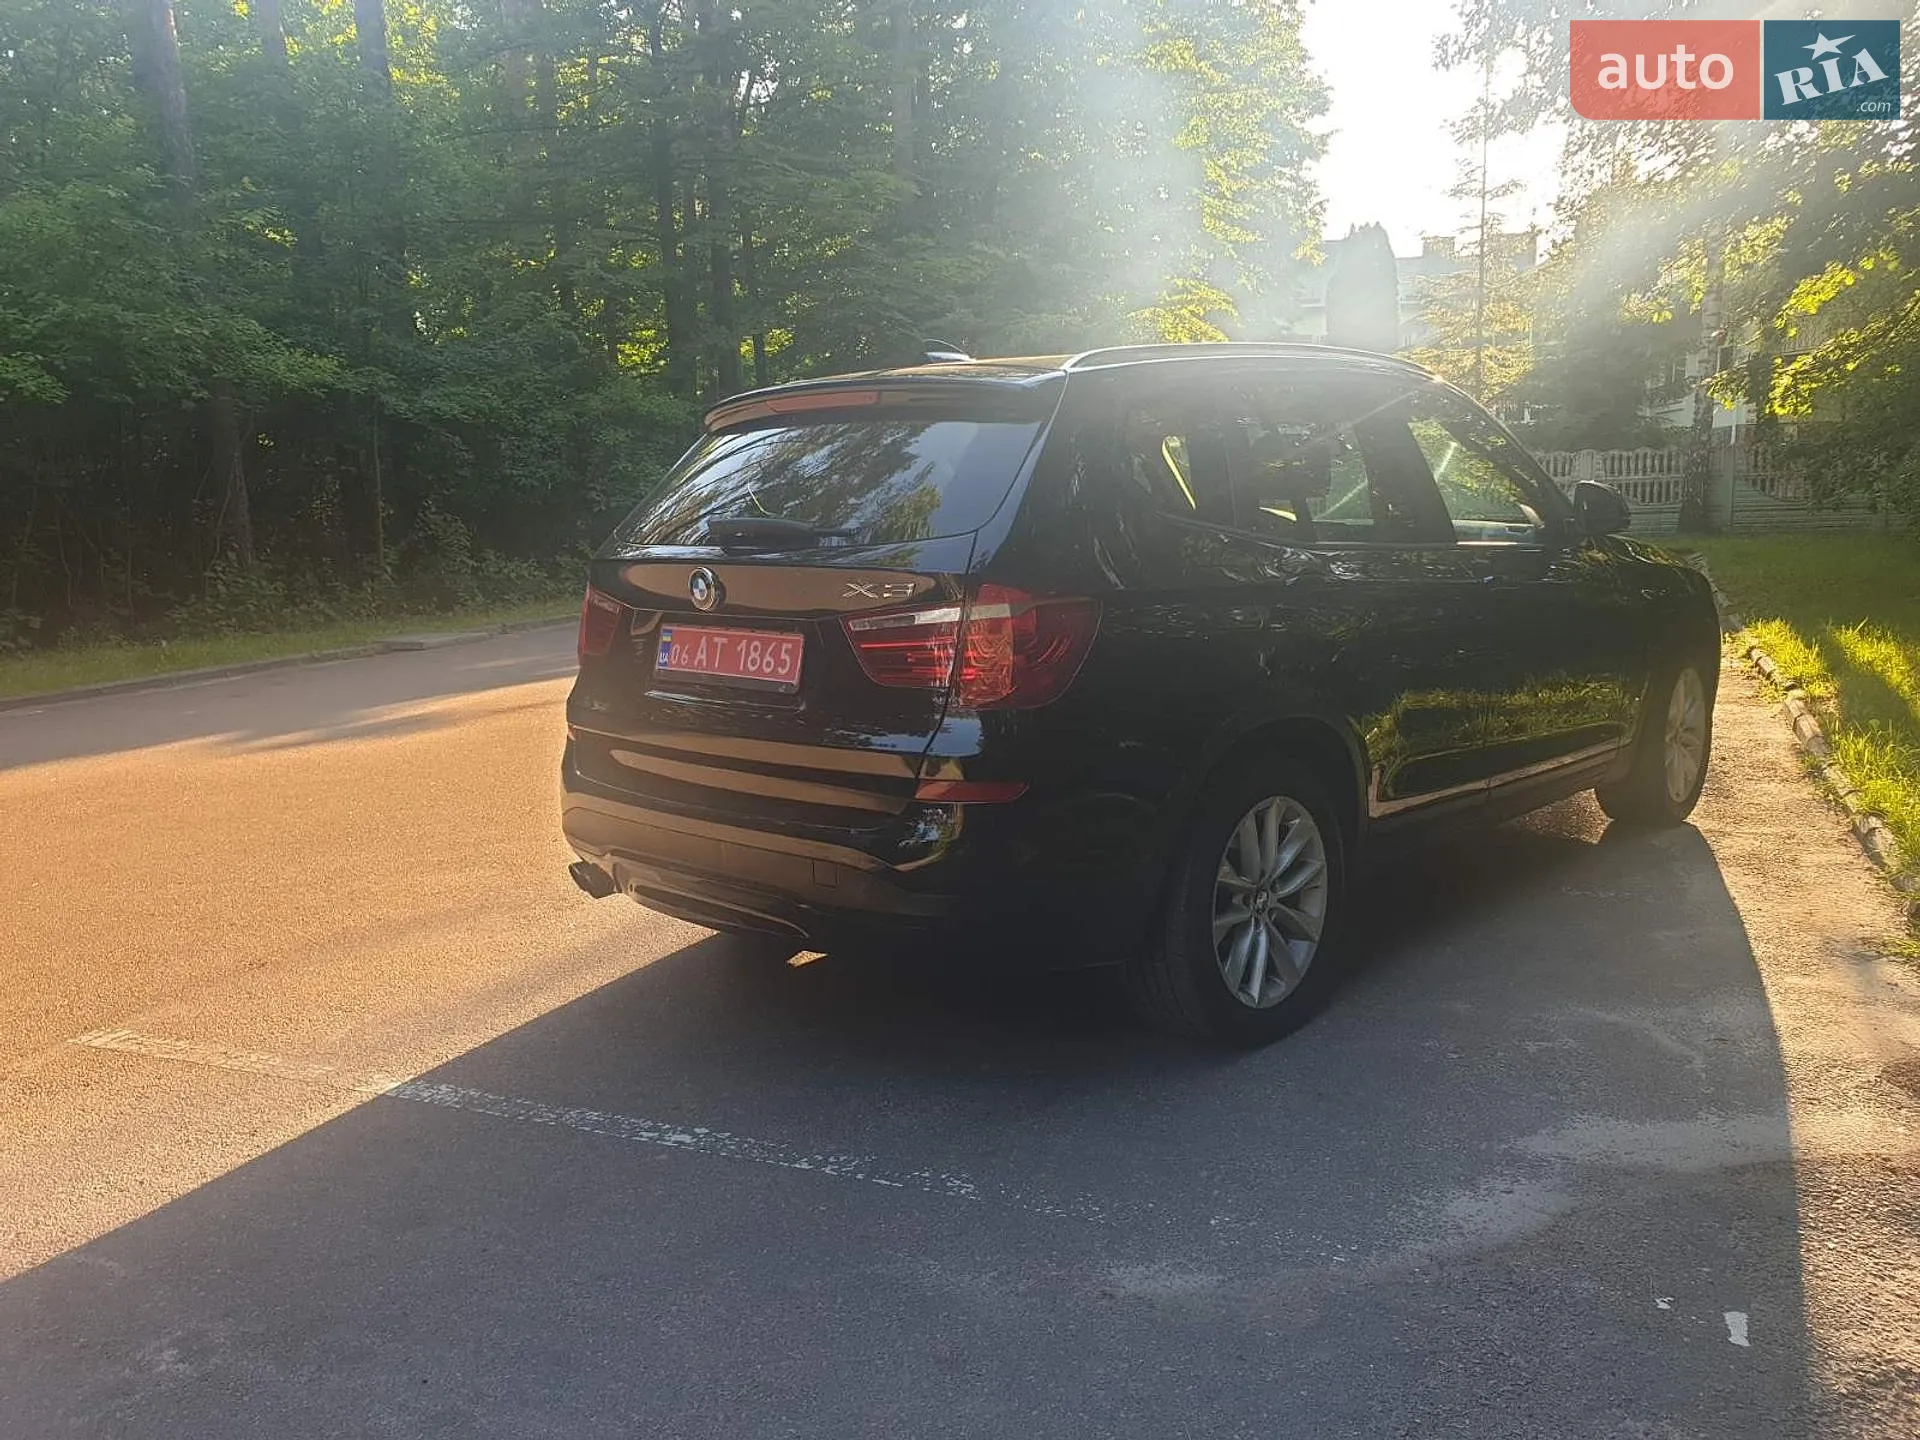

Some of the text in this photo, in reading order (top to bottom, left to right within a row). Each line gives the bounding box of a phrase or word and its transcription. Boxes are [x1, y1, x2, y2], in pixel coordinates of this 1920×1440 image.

[842, 582, 916, 599] X3
[670, 635, 792, 675] 06 AT 1865
